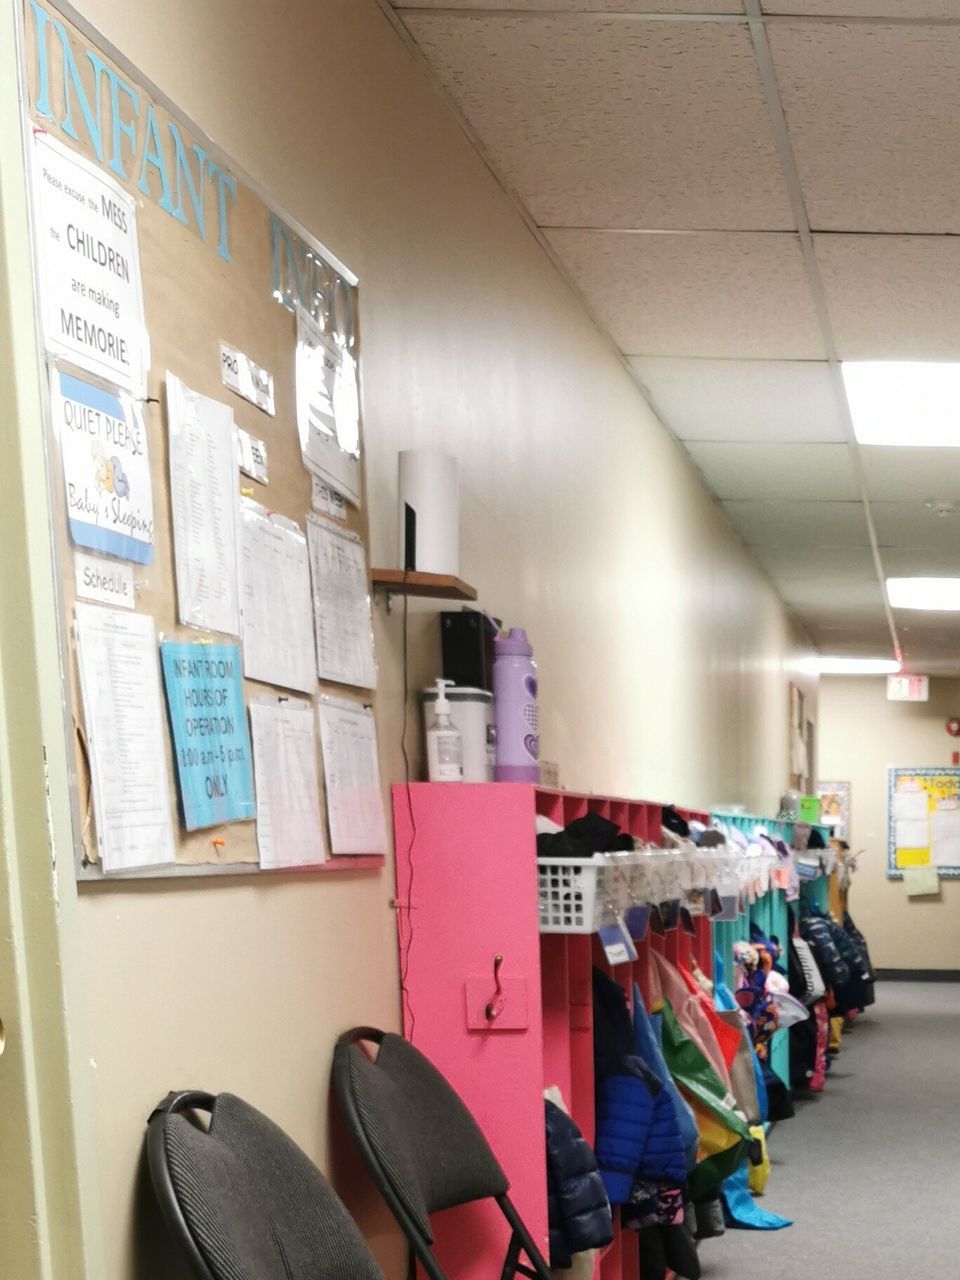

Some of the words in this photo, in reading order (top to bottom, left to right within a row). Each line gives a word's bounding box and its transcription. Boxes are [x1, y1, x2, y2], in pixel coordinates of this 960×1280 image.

[31, 0, 238, 262] INFANT
[101, 194, 127, 234] MESS
[66, 223, 129, 283] CHILDREN
[71, 278, 86, 296] are
[88, 287, 120, 319] making
[64, 400, 100, 435] QUIET
[105, 415, 143, 456] PLEASE
[83, 566, 128, 596] Schedule
[174, 659, 202, 679] INFANT
[204, 661, 233, 679] ROOM
[184, 688, 214, 708] HOURS
[215, 688, 228, 707] OF
[185, 717, 234, 737] OPERATION
[205, 774, 229, 799] ONLY
